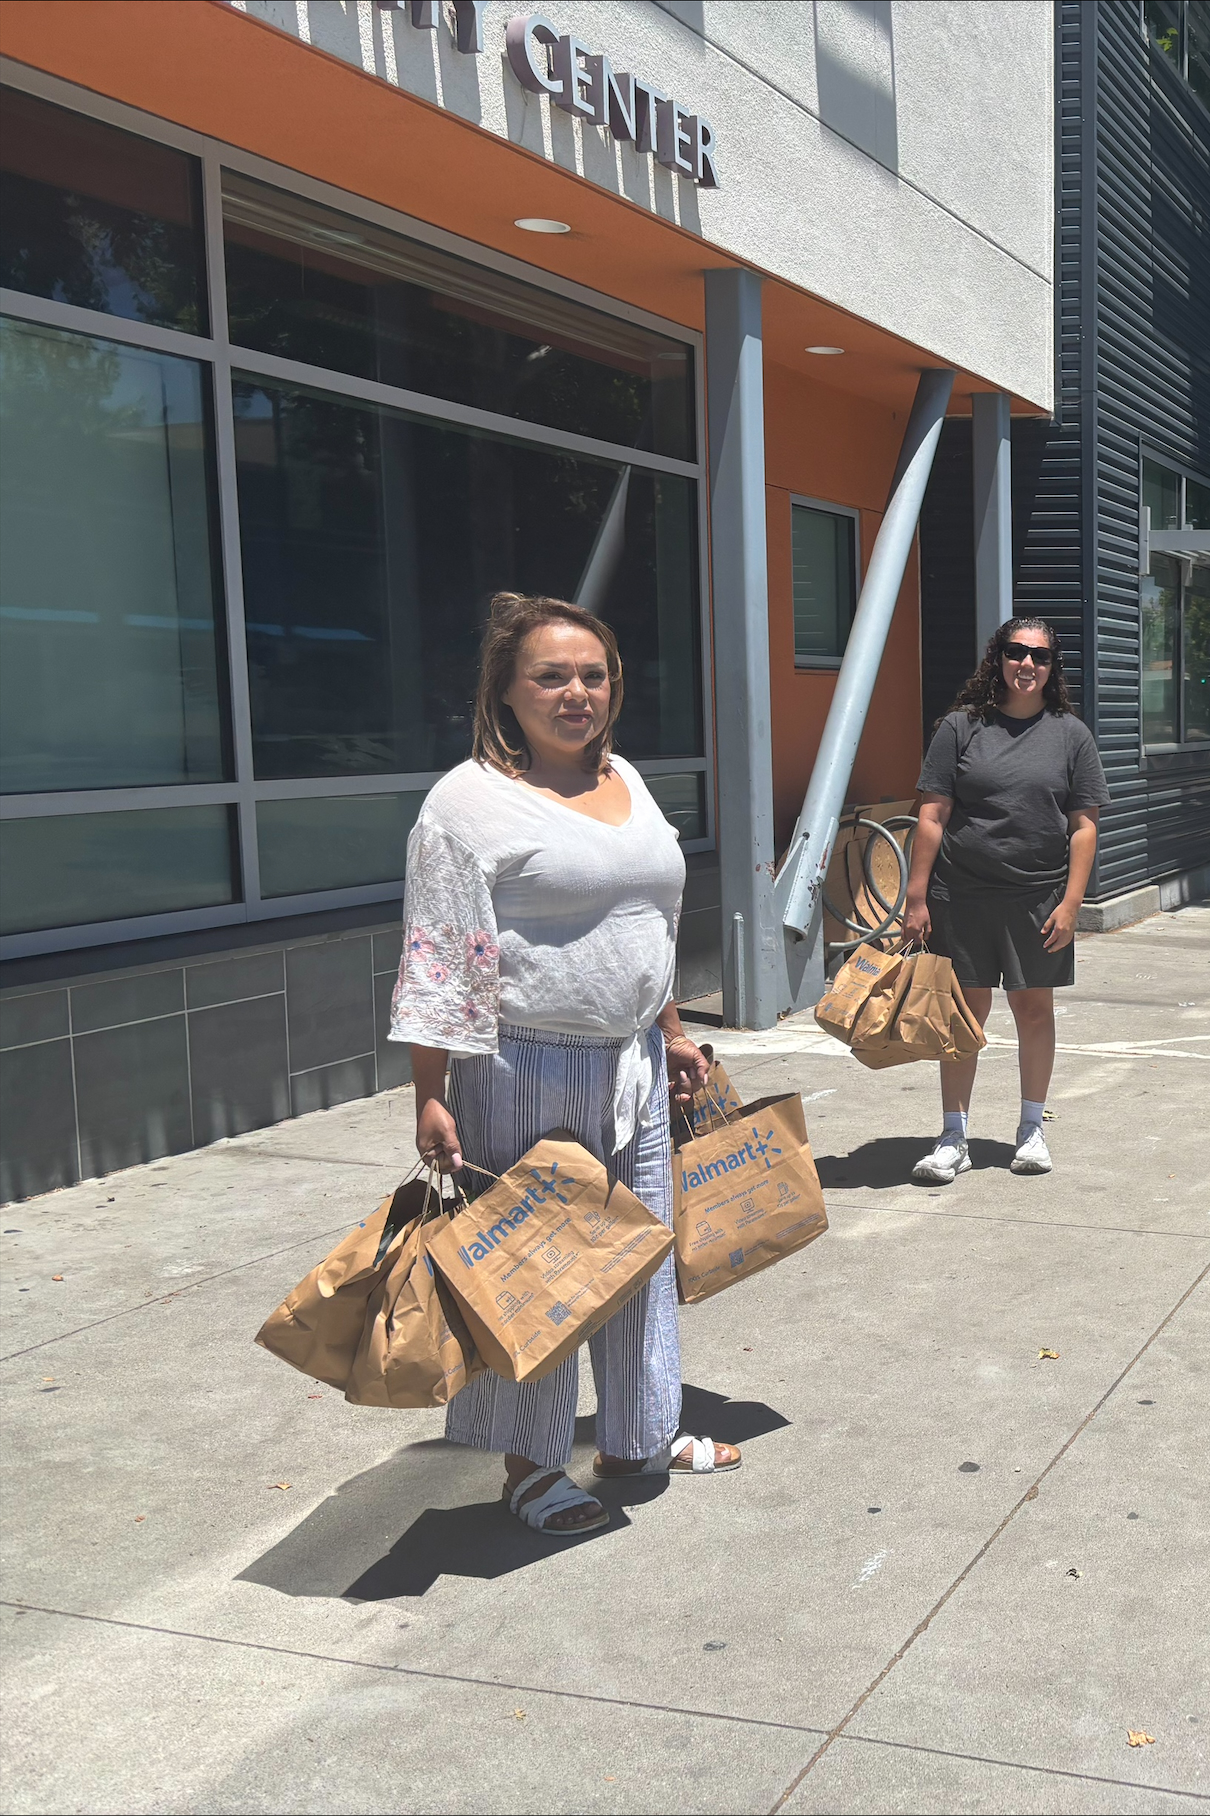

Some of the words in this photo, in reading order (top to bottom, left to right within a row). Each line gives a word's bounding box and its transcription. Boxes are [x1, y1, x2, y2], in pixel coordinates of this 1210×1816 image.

[506, 13, 721, 189] CENTER
[500, 1255, 528, 1282] Members
[527, 1239, 547, 1259] always
[545, 1229, 558, 1242] get
[556, 1217, 571, 1232] more
[519, 1329, 541, 1352] Curbside
